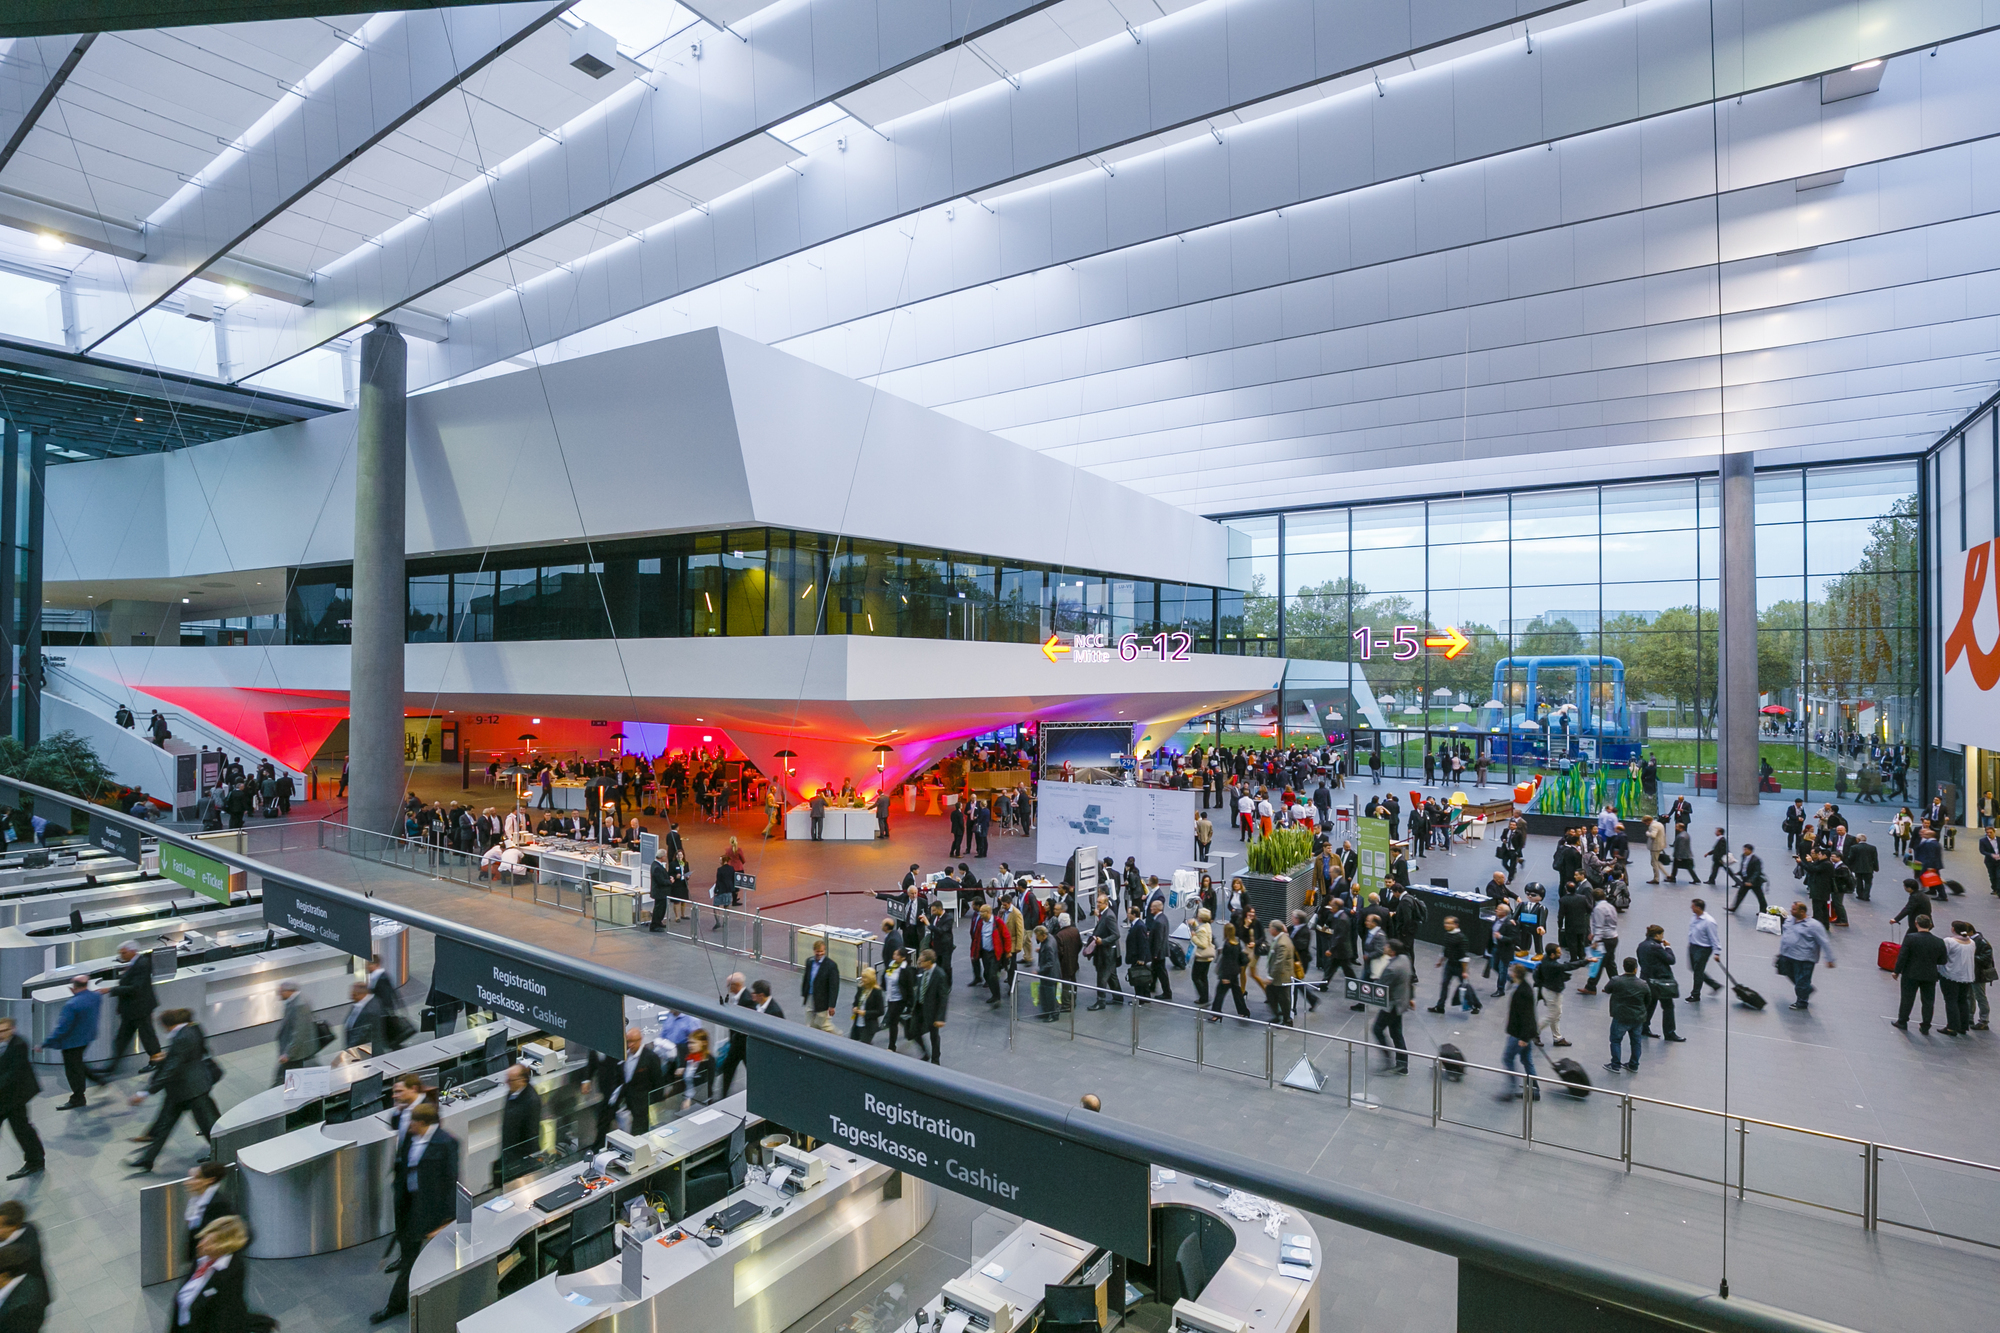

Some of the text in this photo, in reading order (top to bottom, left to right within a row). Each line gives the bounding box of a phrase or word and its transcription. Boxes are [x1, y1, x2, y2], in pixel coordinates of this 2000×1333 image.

[1073, 633, 1104, 648] NCC
[1118, 631, 1192, 663] 6-12
[1352, 625, 1420, 660] 1-5
[1073, 649, 1110, 663] Mitte
[475, 715, 500, 725] 9-12
[1121, 759, 1136, 767] 294
[172, 858, 196, 879] Fast Lane
[201, 871, 224, 891] e-Ticket
[295, 898, 328, 919] Registration
[286, 913, 340, 942] Tageskasse Cashier
[493, 966, 547, 997] Registration
[476, 984, 568, 1029] Tageskasse Cashier
[864, 1092, 976, 1148] Registration
[829, 1114, 1020, 1200] Tageskasse Cashier
